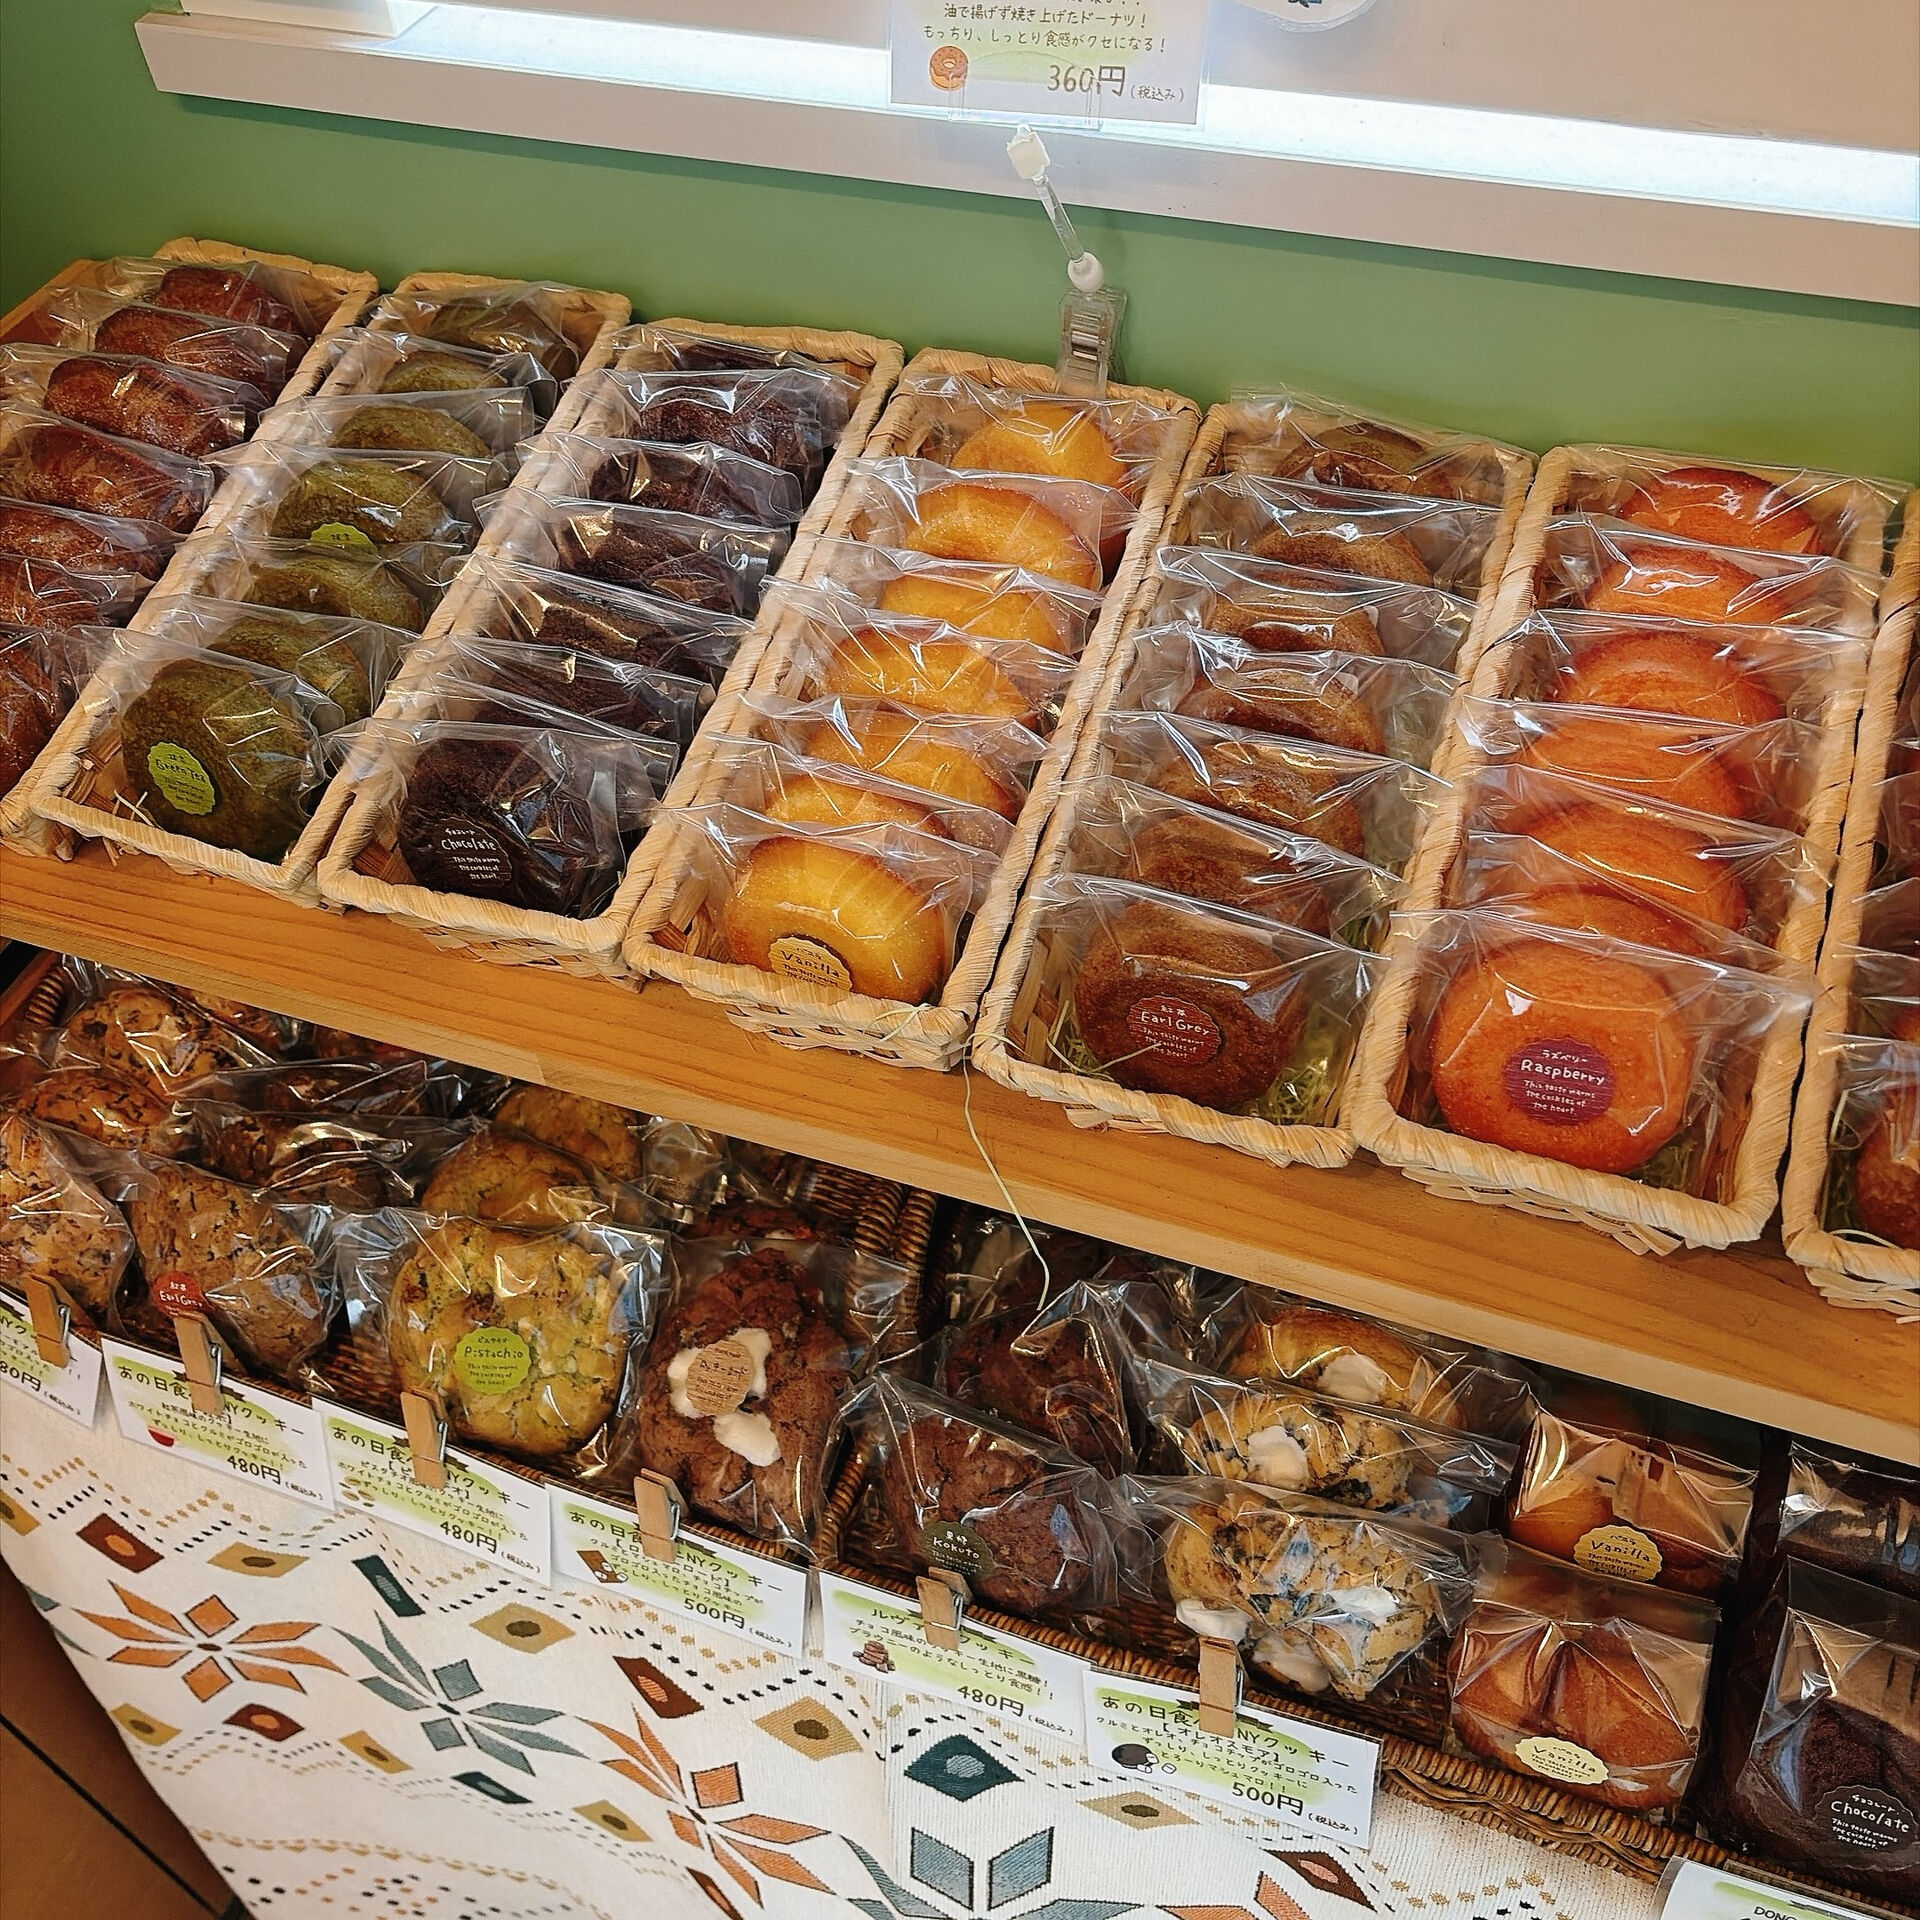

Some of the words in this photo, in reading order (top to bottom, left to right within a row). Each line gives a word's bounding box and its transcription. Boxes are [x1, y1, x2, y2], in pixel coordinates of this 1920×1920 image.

[944, 3, 1147, 29] 油で揚げず焼き上げたドーナツ！
[924, 25, 1166, 53] もっちり、しっとり食感がクセになる！
[441, 837, 497, 851] Chocolate
[781, 950, 840, 978] Vanilla
[1140, 1010, 1172, 1027] Earl
[1175, 1019, 1210, 1036] Grey
[1542, 1049, 1588, 1063] ラズベリー
[1520, 1059, 1605, 1085] Raspberry
[1523, 1079, 1542, 1089] This
[1544, 1082, 1567, 1094] taste
[1568, 1088, 1596, 1099] warms
[159, 1290, 180, 1303] Earl
[464, 1345, 523, 1359] Pistachio
[227, 1455, 281, 1485] 480円
[440, 1520, 497, 1554] 480円
[933, 1536, 980, 1559] Kokuto
[1591, 1540, 1650, 1562] Vanilla
[684, 1597, 745, 1630] 500円
[957, 1685, 1024, 1718] 480円
[1533, 1745, 1597, 1773] Vanilla
[1232, 1781, 1304, 1817] 500円
[1830, 1800, 1910, 1833] Chocolate
